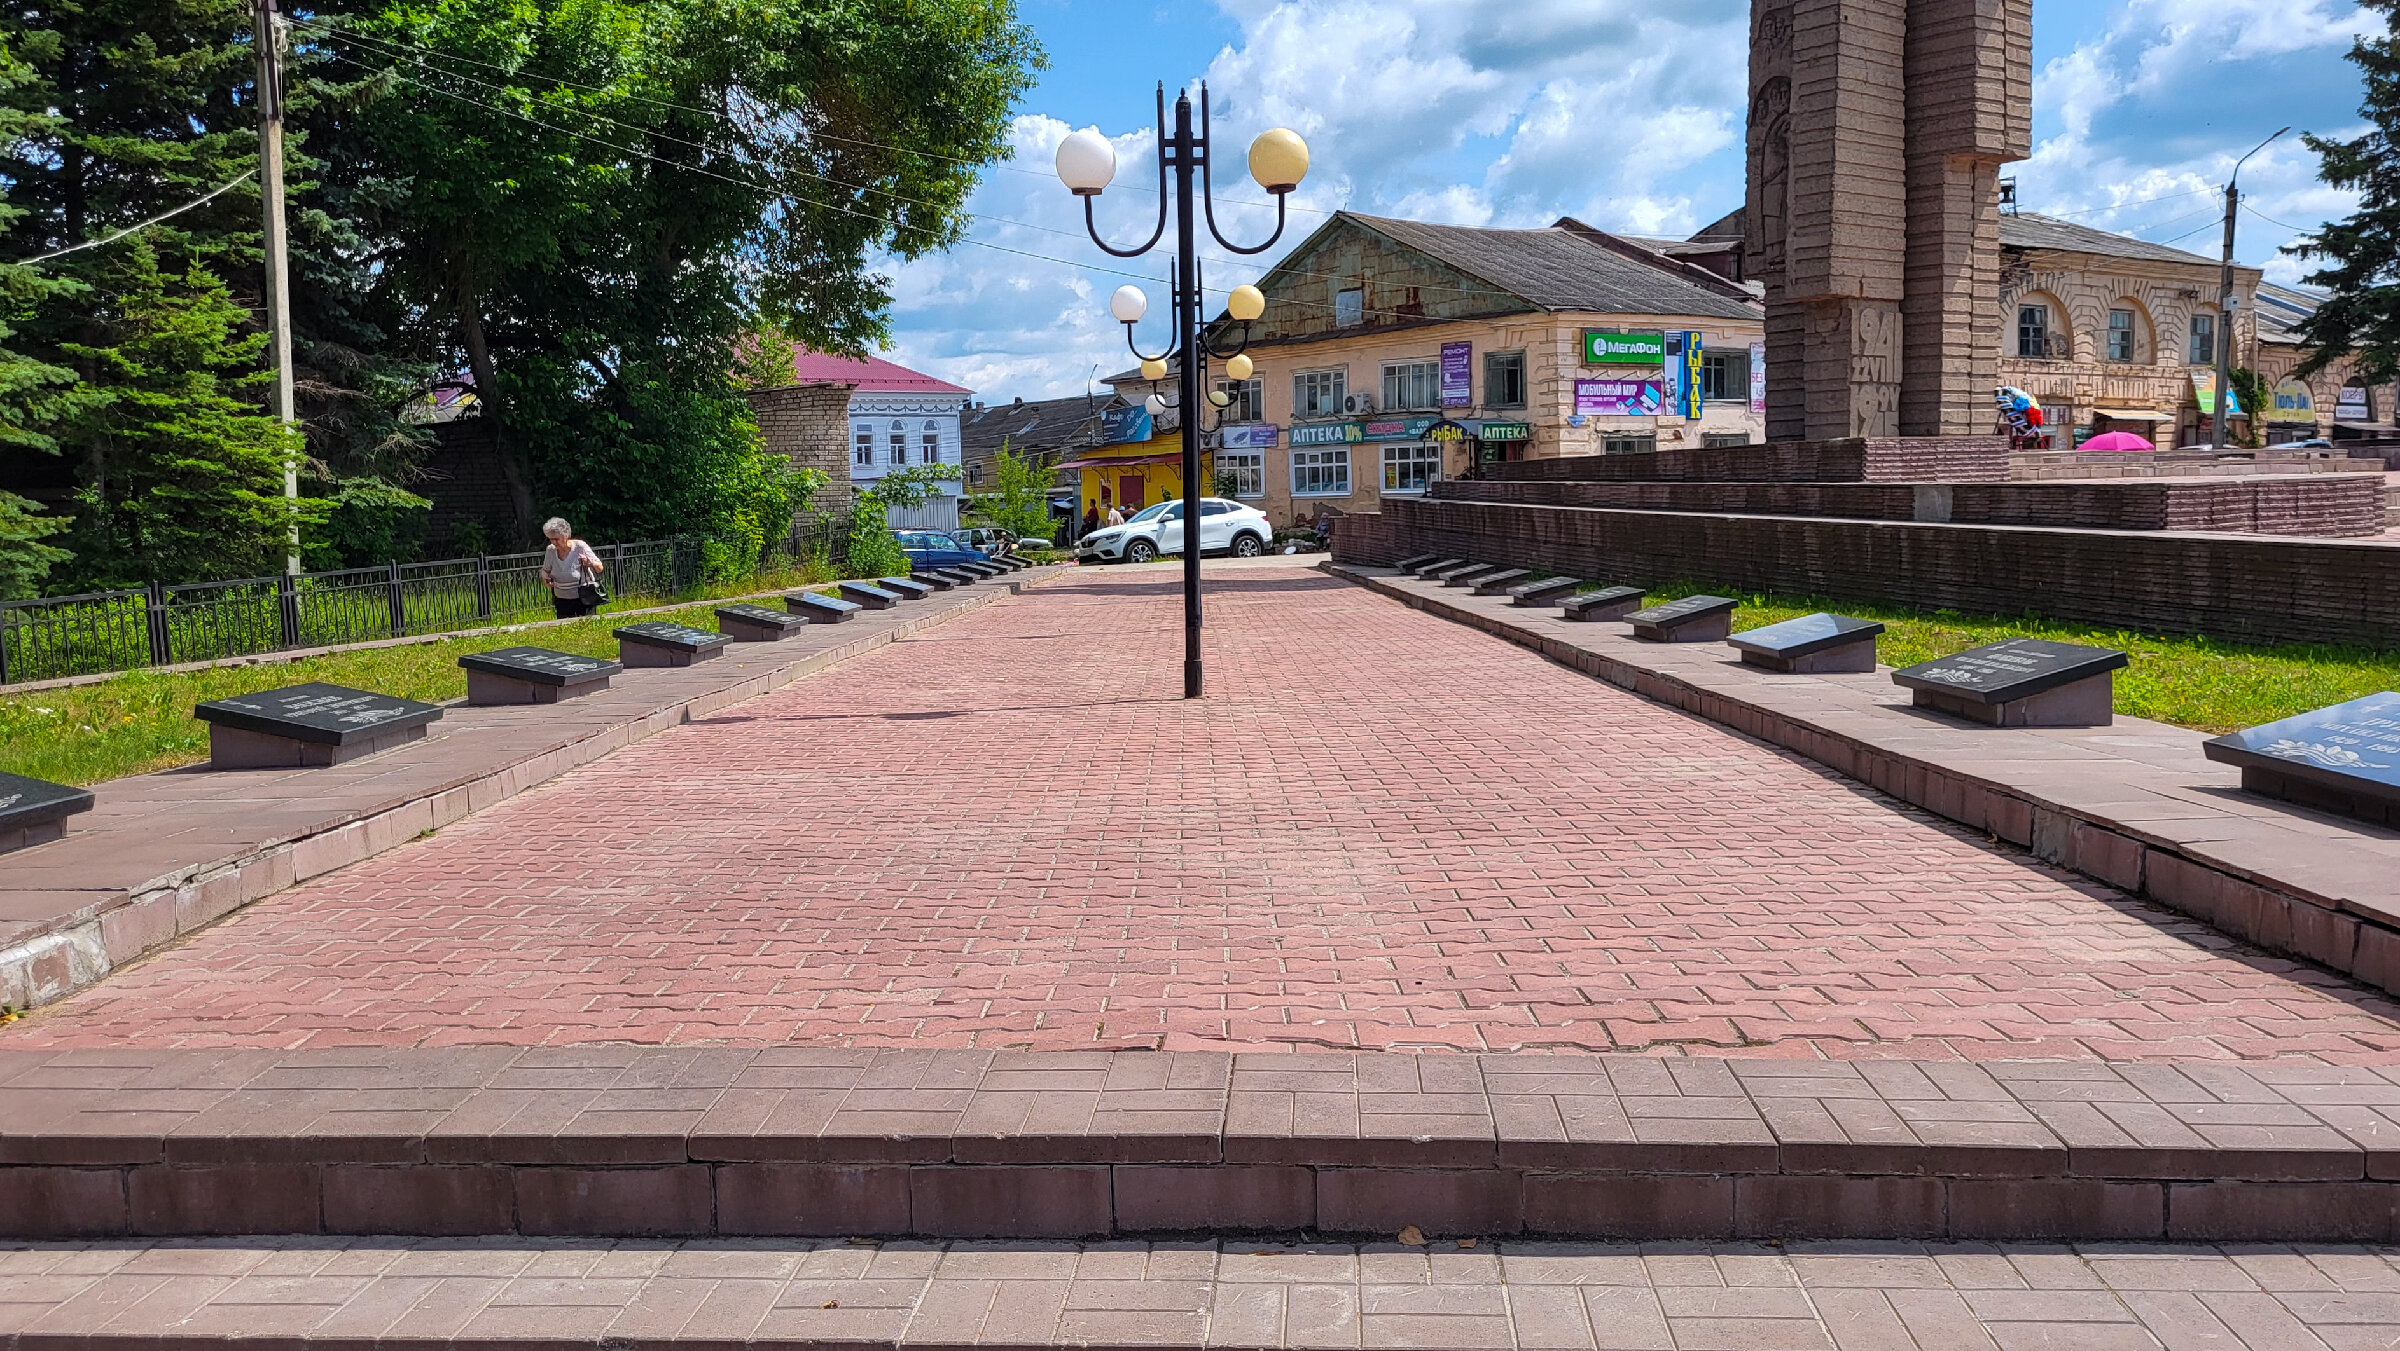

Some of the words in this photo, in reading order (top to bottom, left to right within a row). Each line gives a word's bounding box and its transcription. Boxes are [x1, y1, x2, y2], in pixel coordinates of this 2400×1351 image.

[1688, 332, 1703, 419] РЫБАК
[1578, 382, 1622, 396] МОБИЛЬНЫЙ
[1623, 384, 1637, 396] МИР
[1292, 426, 1344, 443] АПТЕКА
[1366, 421, 1405, 434] СКИДКА
[1431, 424, 1464, 442] РЫБАК
[1483, 426, 1528, 440] АПТЕКА
